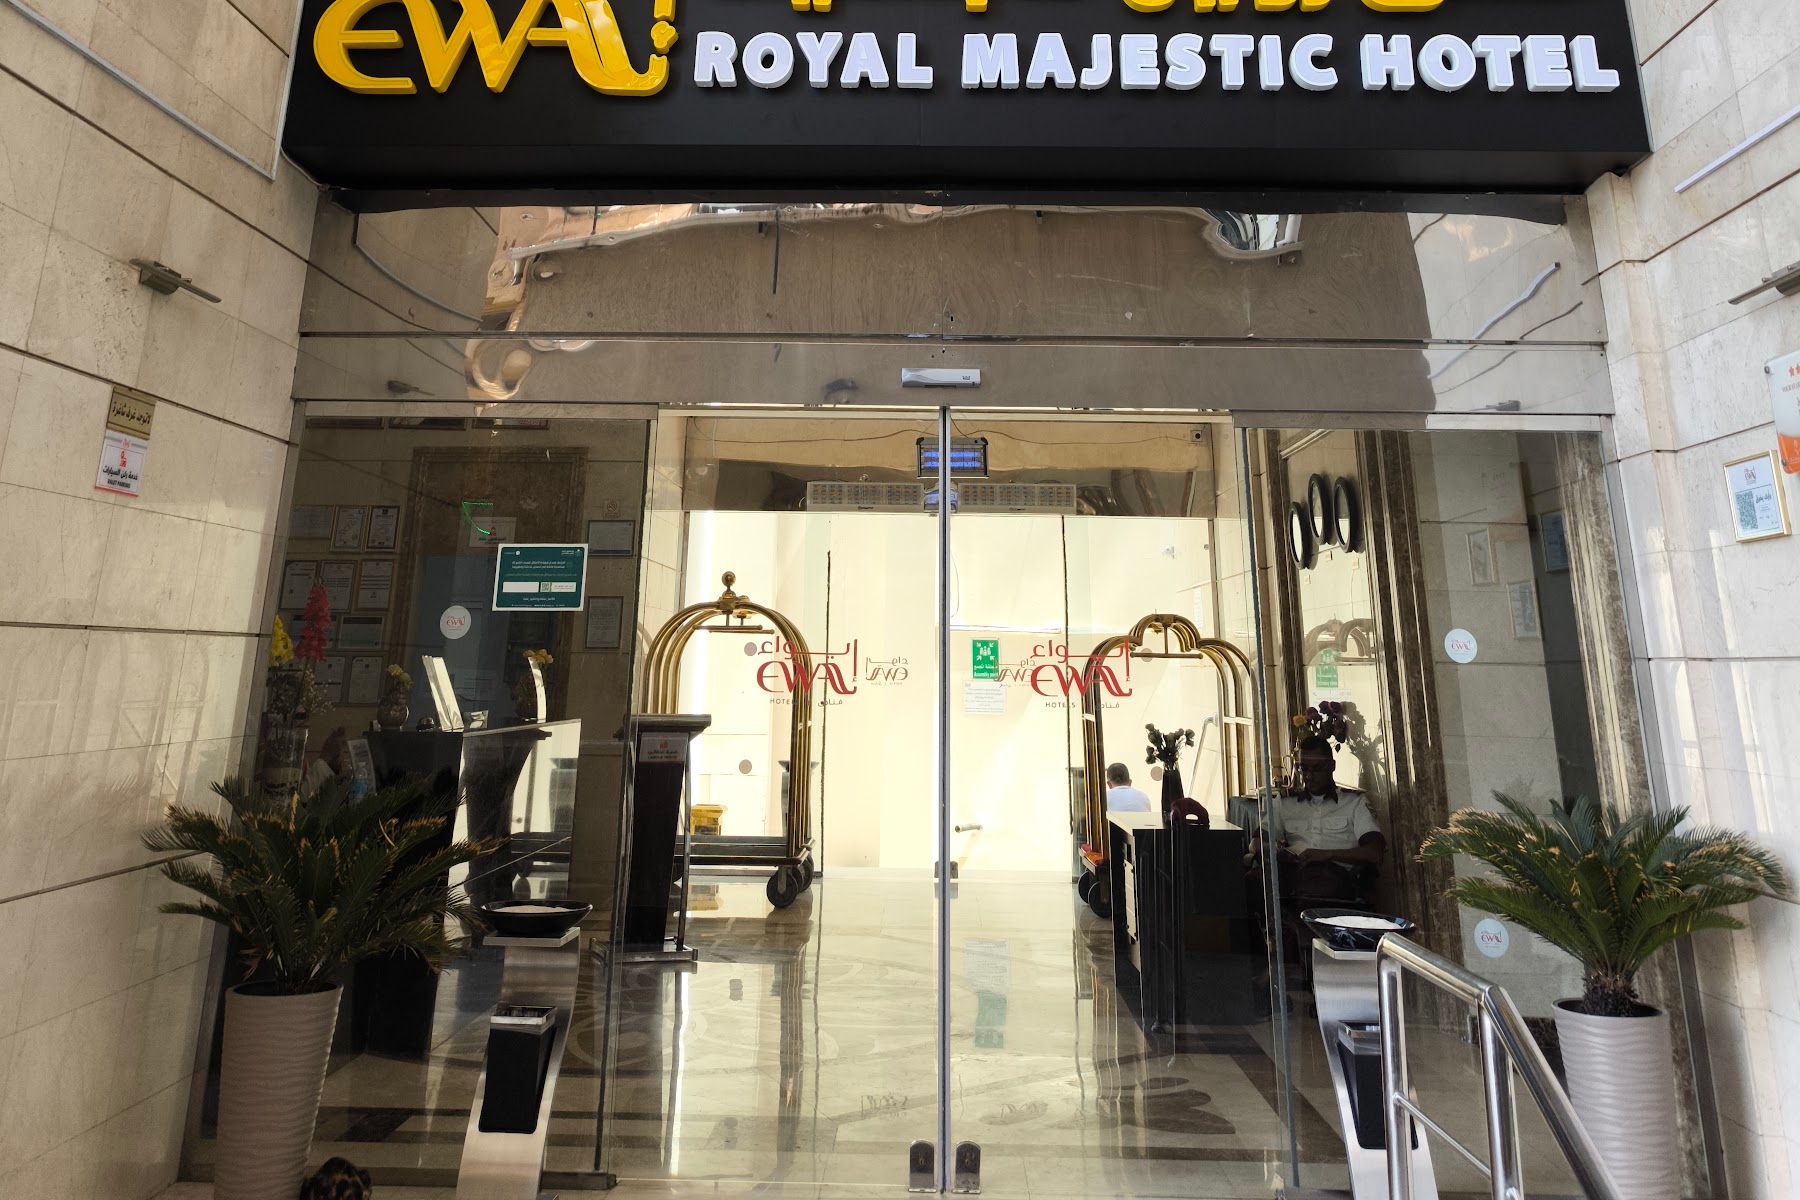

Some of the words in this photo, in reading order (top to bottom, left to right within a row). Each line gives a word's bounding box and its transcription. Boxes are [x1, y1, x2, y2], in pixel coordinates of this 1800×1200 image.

[693, 31, 934, 90] ROYAL
[961, 32, 1339, 92] MAJESTIC
[1359, 33, 1620, 93] HOTEL
